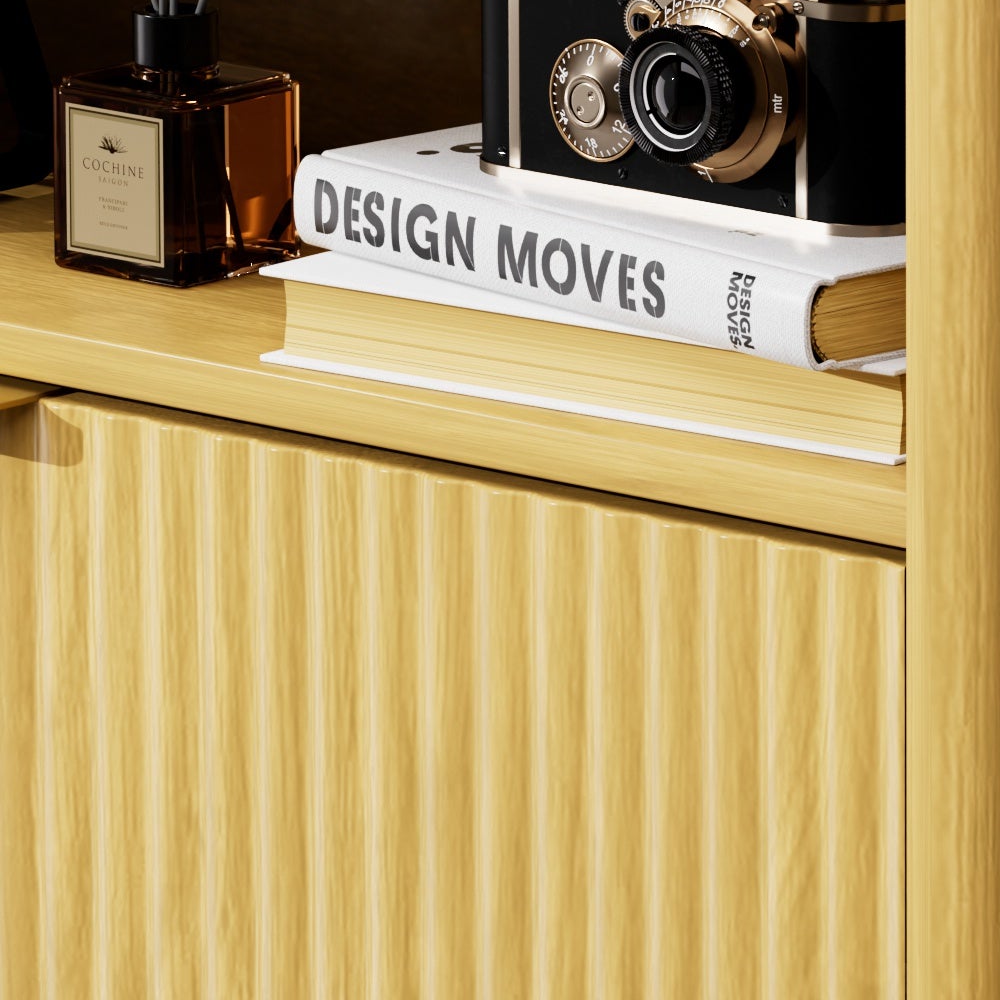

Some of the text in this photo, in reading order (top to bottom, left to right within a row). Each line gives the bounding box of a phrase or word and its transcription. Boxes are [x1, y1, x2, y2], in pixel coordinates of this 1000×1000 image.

[772, 94, 783, 113] mtr
[612, 119, 626, 134] 12
[82, 157, 144, 180] COCHINE
[313, 178, 666, 319] DESIGN MOVES
[740, 274, 756, 350] DESIGN
